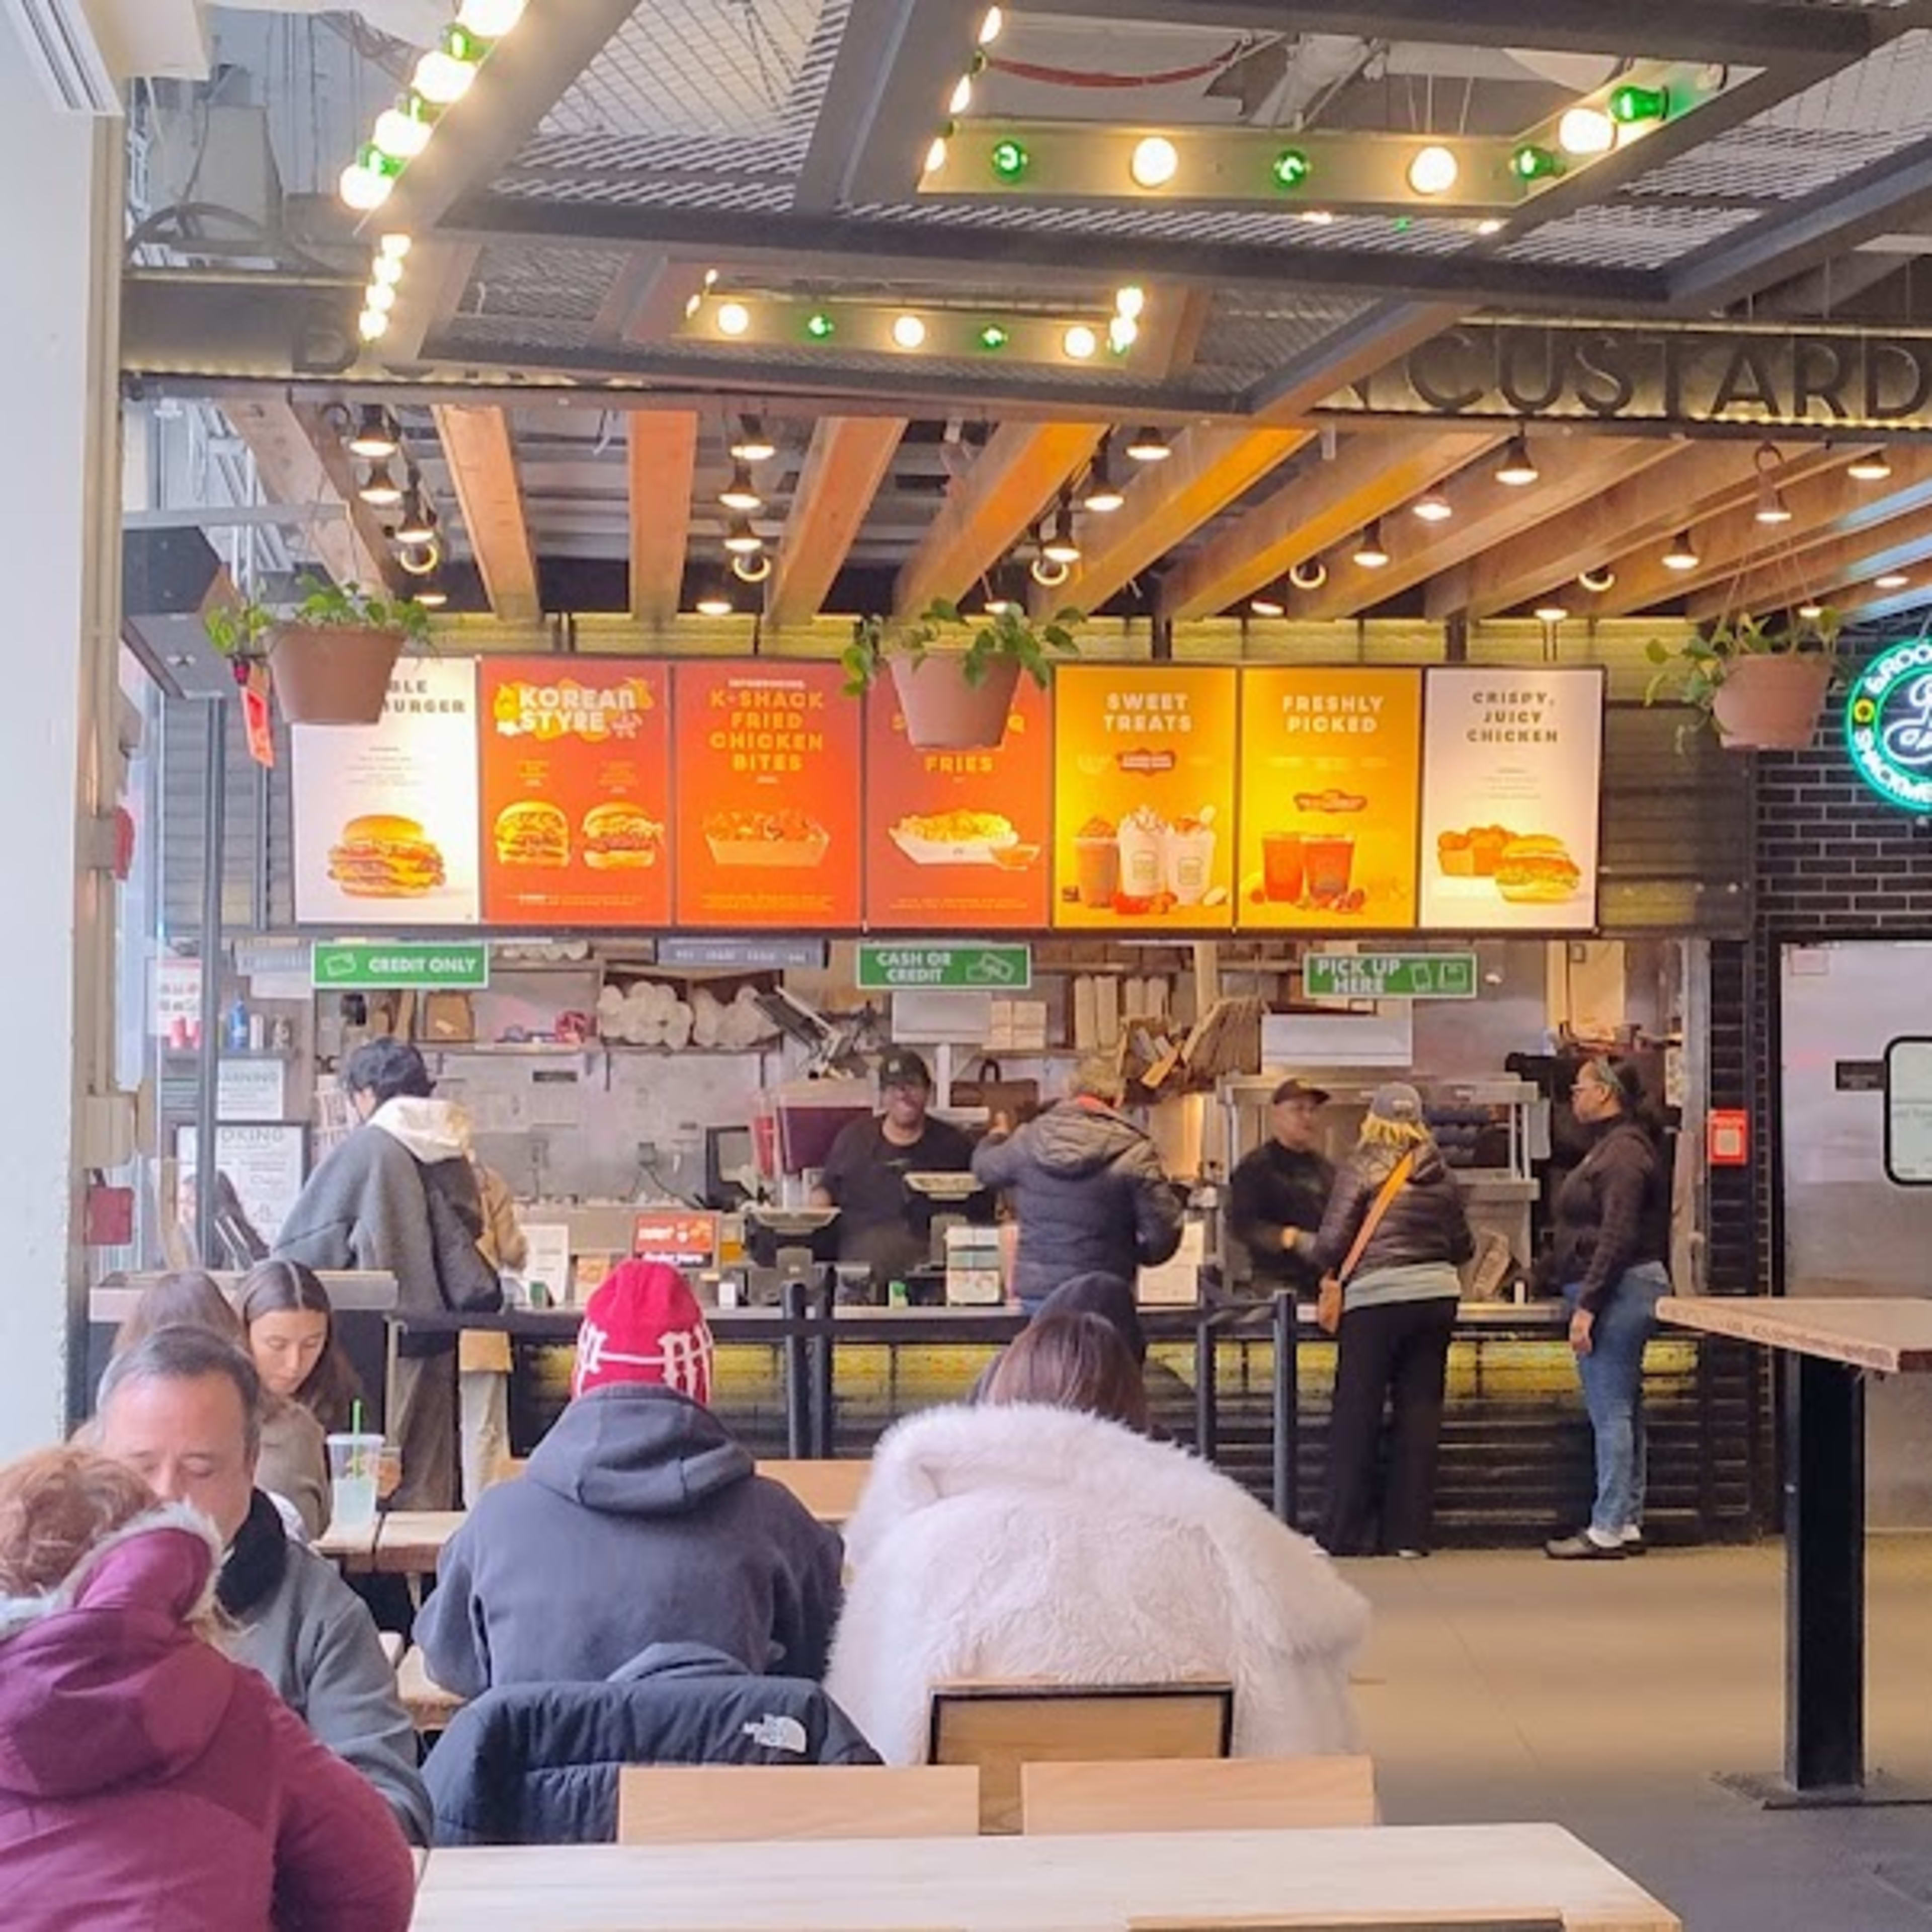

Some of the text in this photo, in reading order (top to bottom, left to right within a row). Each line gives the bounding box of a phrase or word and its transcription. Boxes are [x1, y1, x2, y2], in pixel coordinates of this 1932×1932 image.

[1407, 325, 1931, 420] CUSTARD
[391, 680, 427, 693] BLE
[383, 700, 465, 713] BURGER
[710, 689, 823, 708] K-SHACK
[1108, 692, 1188, 710] SWEET
[1283, 695, 1384, 712] FRESHLY
[1473, 692, 1554, 705] CRISPY,
[731, 712, 803, 729] FRIED
[1104, 714, 1191, 732] TREATS
[1286, 716, 1378, 733] PICKED
[1484, 711, 1541, 722] JUICY
[709, 732, 823, 750] CHICKEN
[1467, 730, 1558, 742] CHICKEN
[733, 754, 802, 770] BITES
[925, 757, 993, 772] FRIES
[368, 957, 476, 973] CREDIT ONLY
[875, 952, 951, 966] CASH OR
[1318, 958, 1401, 976] PICK UP
[886, 969, 943, 982] CREDIT
[1334, 978, 1385, 993] HERE
